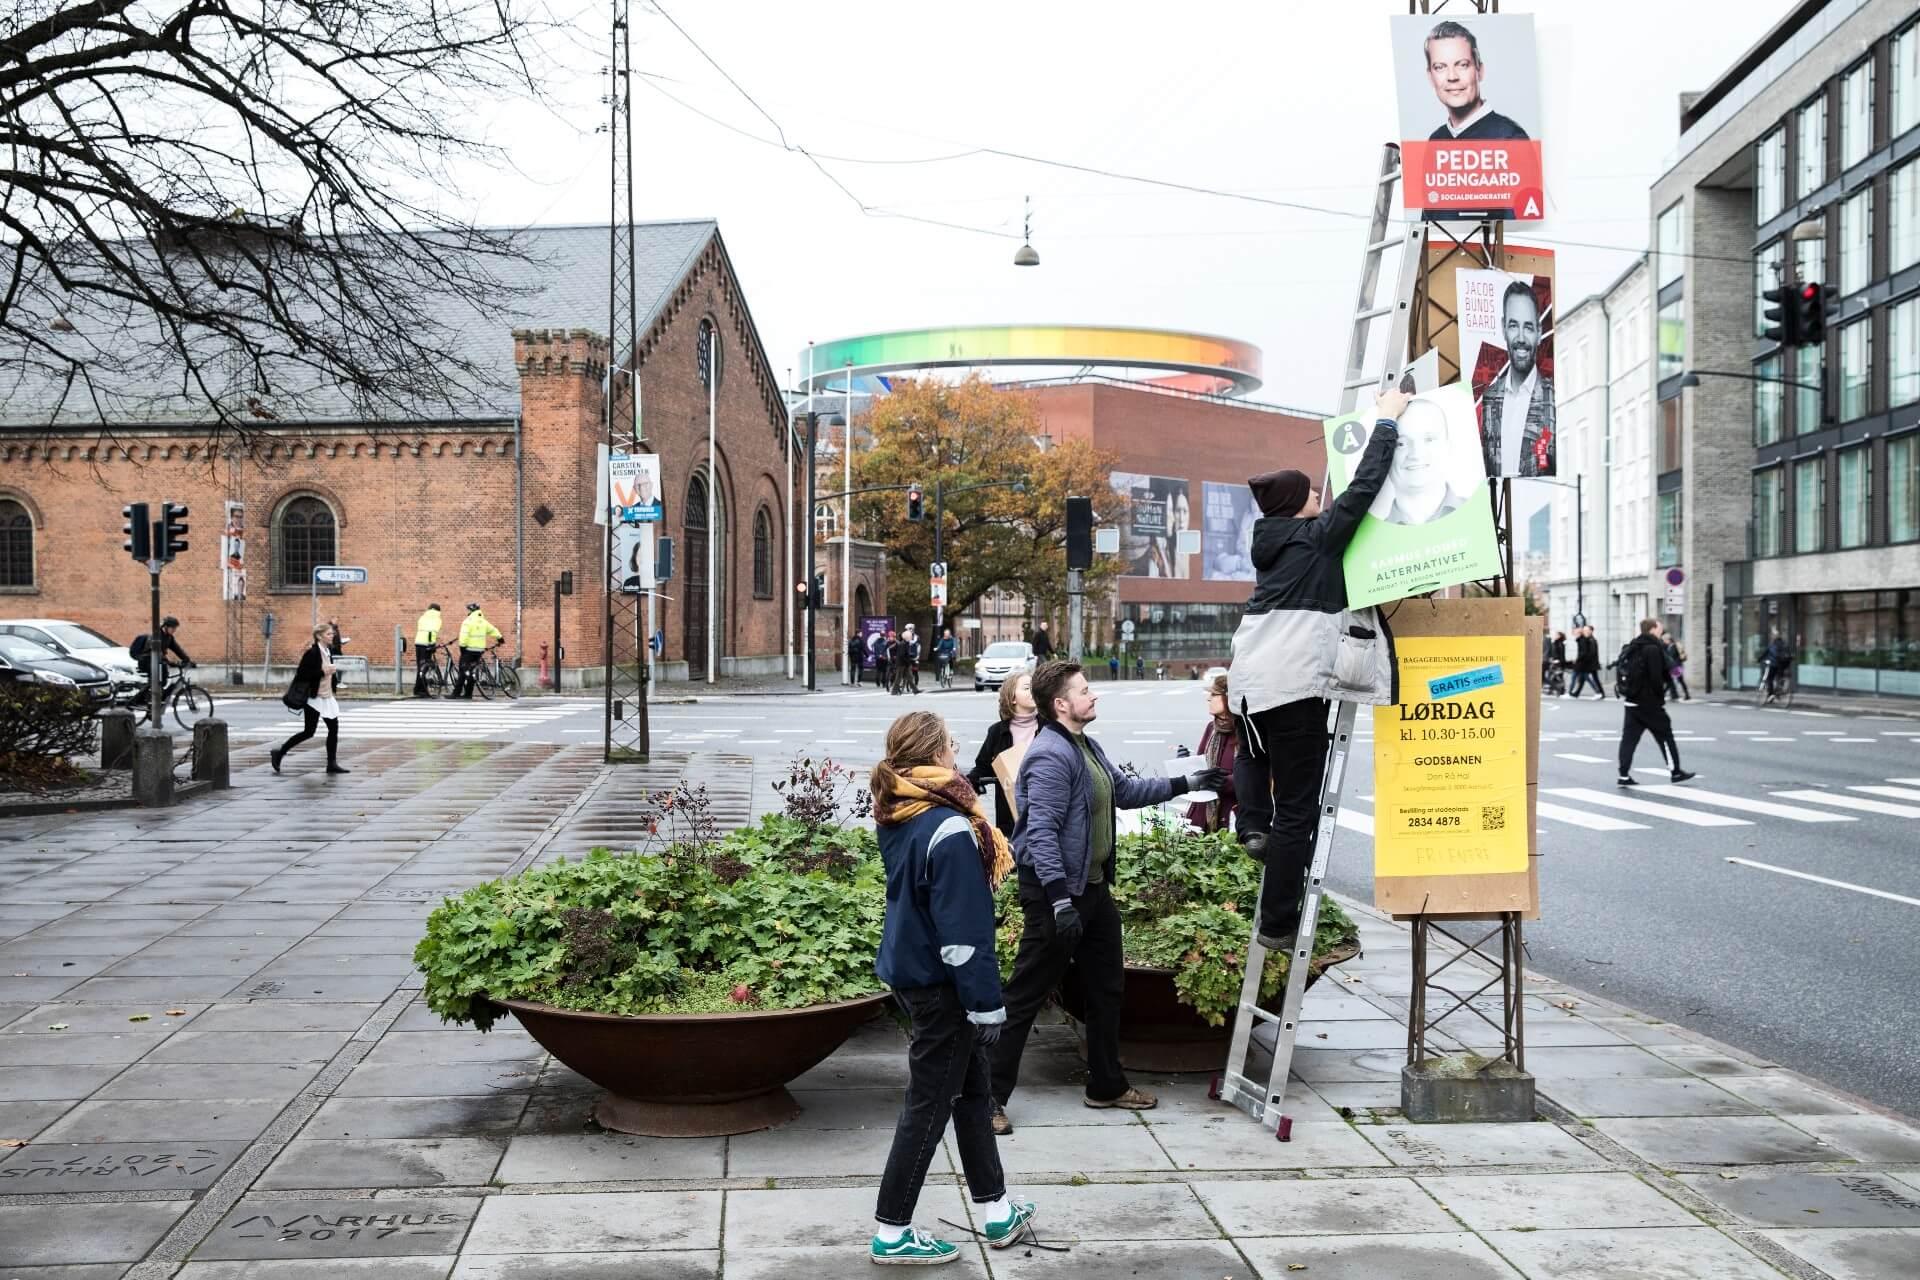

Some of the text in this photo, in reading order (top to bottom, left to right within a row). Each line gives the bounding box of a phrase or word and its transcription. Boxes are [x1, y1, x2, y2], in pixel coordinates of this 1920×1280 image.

[1436, 149, 1508, 170] PEDER
[1425, 172, 1520, 187] UDENGAARD
[1440, 192, 1511, 201] SOCIALDEMOKRATIET
[1523, 196, 1540, 217] A
[1465, 280, 1494, 297] JACOB
[1465, 297, 1495, 313] BUNDS
[1466, 313, 1496, 330] GAARD
[1342, 423, 1360, 451] Å
[1376, 551, 1467, 582] ALTERNATIVET
[1430, 677, 1471, 695] GRATIS
[1400, 701, 1496, 721] LØRDAG
[1400, 727, 1496, 741] kl. 10.30-15.00
[1414, 755, 1482, 766] GODSBANEN
[1408, 816, 1460, 827] 2834 4878
